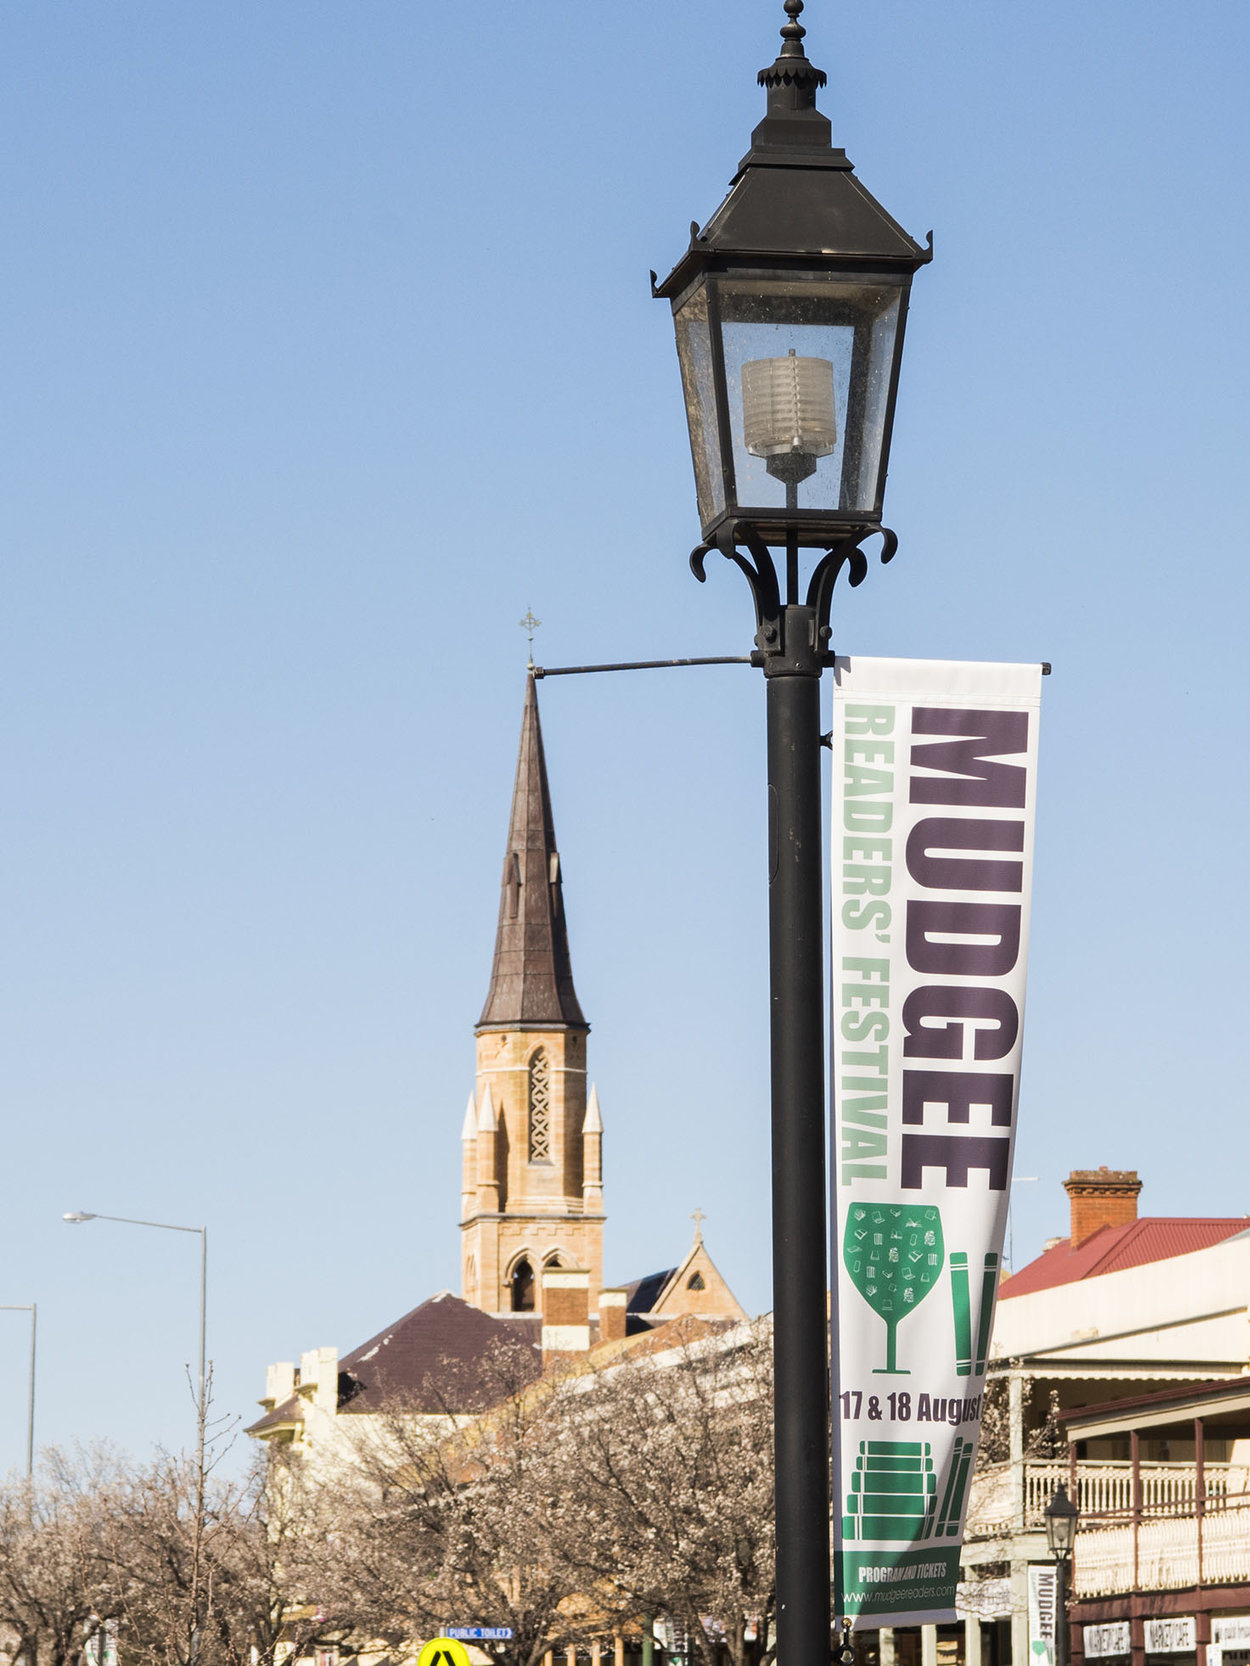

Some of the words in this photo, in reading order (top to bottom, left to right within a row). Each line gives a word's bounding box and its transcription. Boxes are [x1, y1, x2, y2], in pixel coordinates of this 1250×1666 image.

[842, 704, 896, 944] READERS'
[901, 706, 1030, 1191] MUDGEE
[841, 956, 891, 1187] FESTIVAL
[839, 1391, 863, 1420] 17
[868, 1396, 883, 1421] &
[887, 1392, 912, 1422] 18
[917, 1393, 982, 1426] August
[916, 1561, 948, 1580] TICKETS
[1037, 1573, 1055, 1639] MUDGEE
